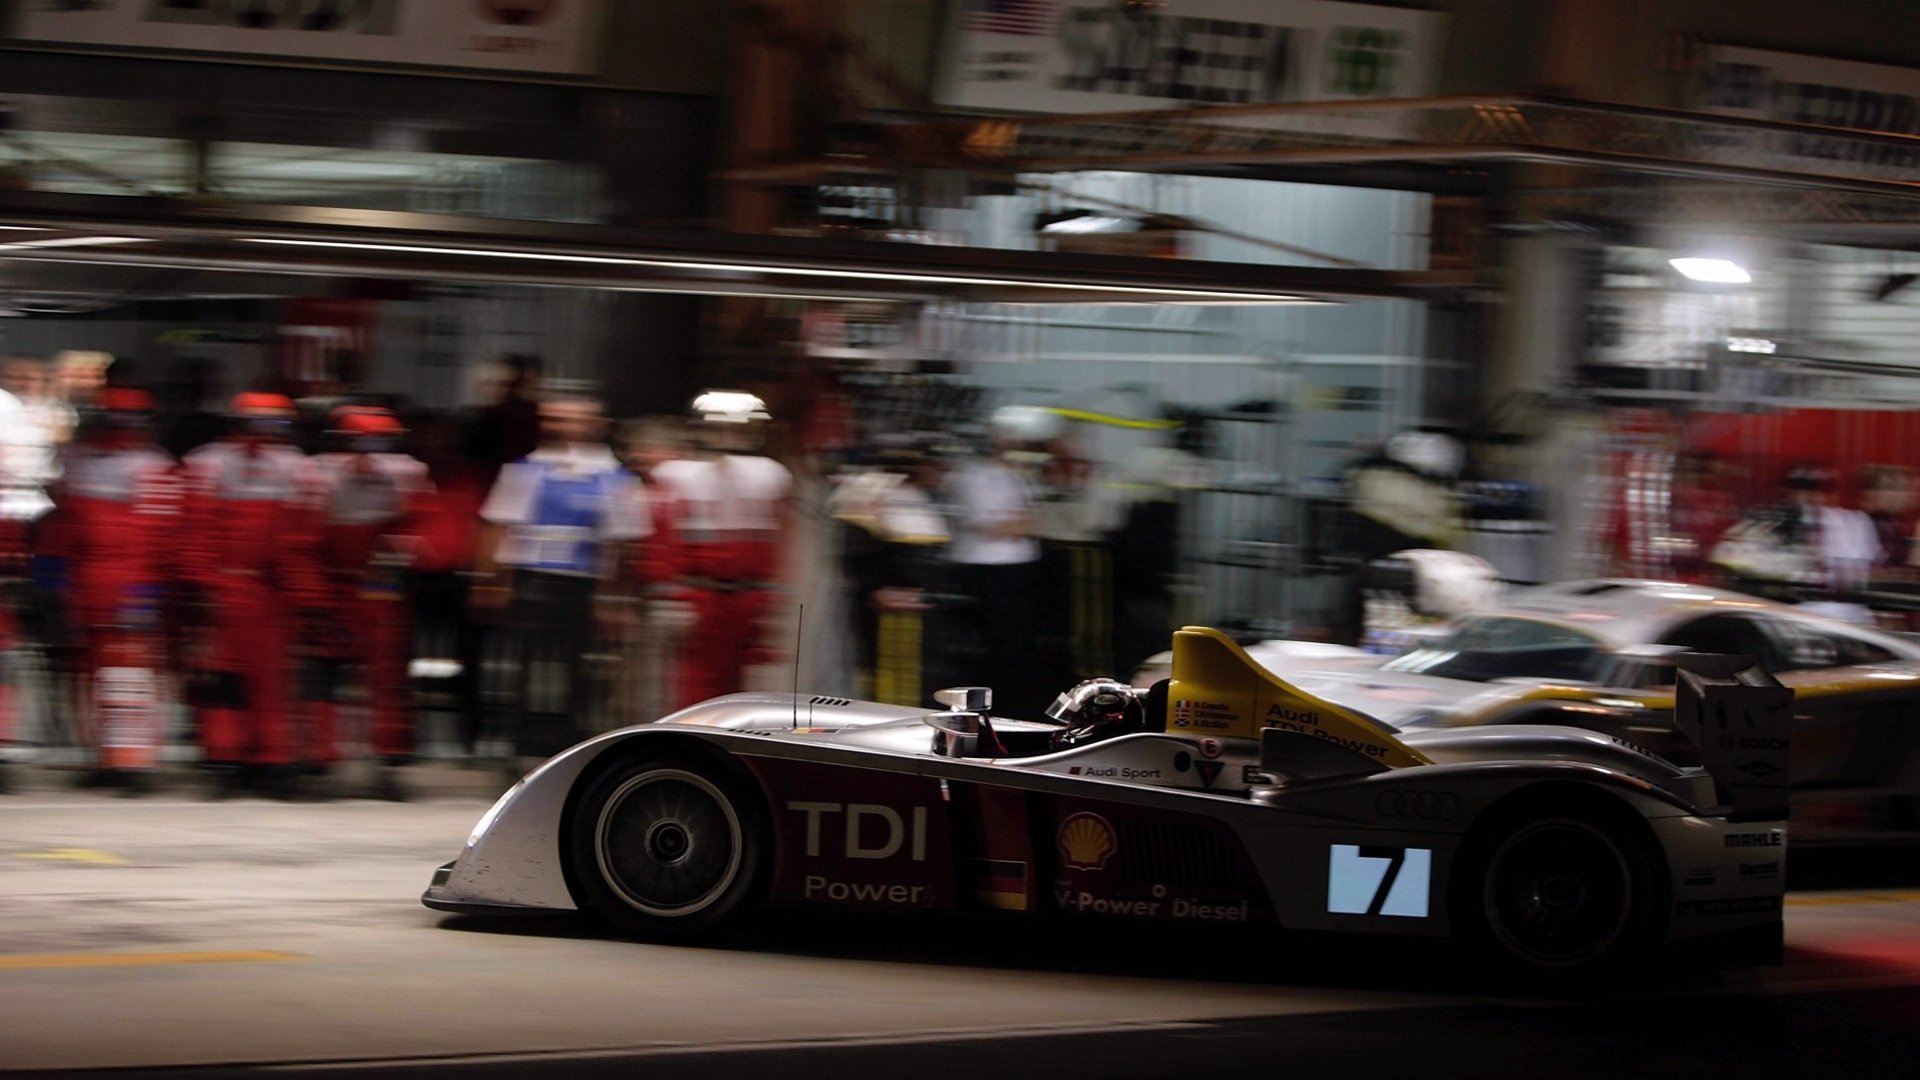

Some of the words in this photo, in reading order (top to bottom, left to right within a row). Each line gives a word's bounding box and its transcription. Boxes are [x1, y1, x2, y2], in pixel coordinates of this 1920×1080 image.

[1267, 704, 1318, 725] Audi
[1206, 740, 1216, 754] E
[1086, 767, 1117, 777] Audi
[1122, 768, 1161, 779] Sport
[786, 801, 928, 861] TDI
[804, 875, 924, 902] Power
[1359, 845, 1404, 914] 7
[1055, 891, 1160, 916] V-Power
[1172, 899, 1248, 921] Diesel
